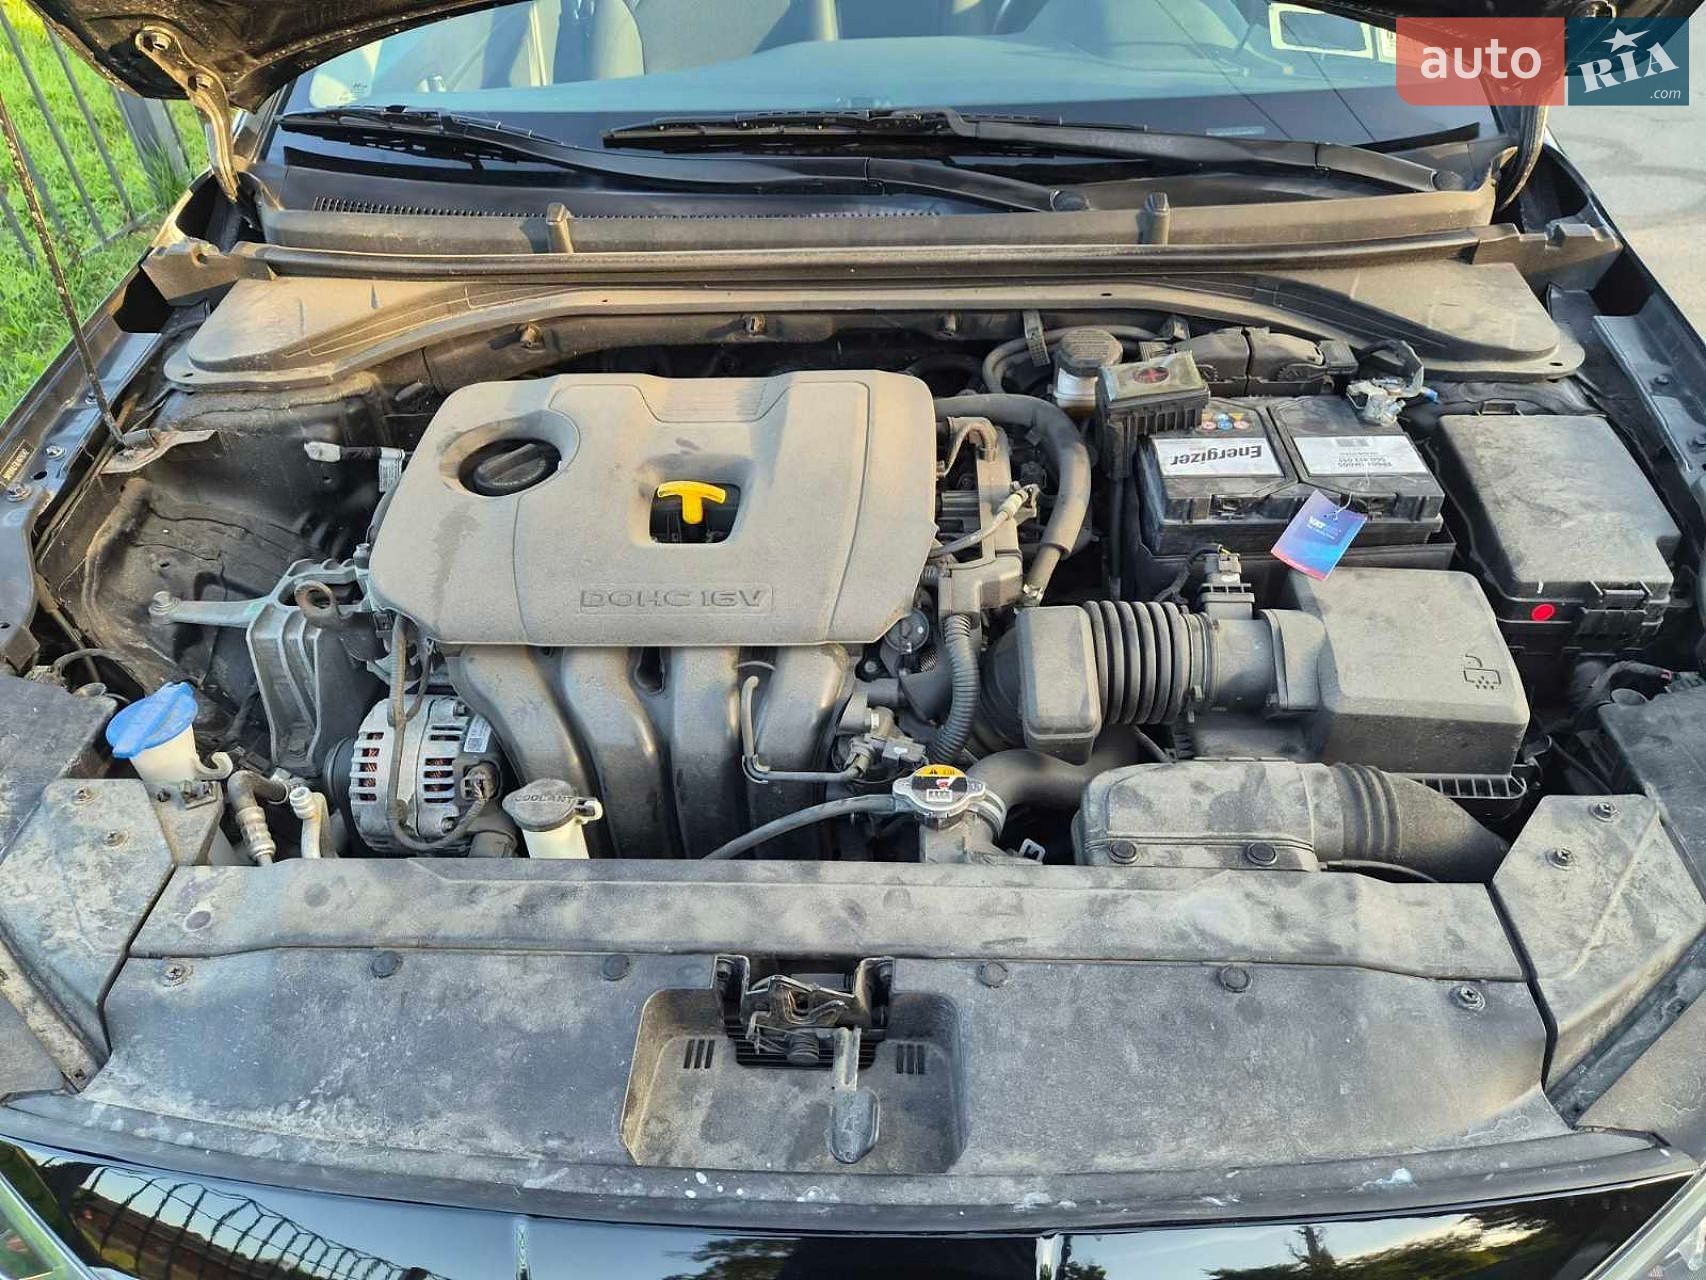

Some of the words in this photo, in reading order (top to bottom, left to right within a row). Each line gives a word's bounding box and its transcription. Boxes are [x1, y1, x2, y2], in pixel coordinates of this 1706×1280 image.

[1170, 445, 1262, 466] Energizer
[580, 589, 691, 608] DOHC
[701, 589, 768, 608] 16V
[514, 793, 573, 805] COOLANT
